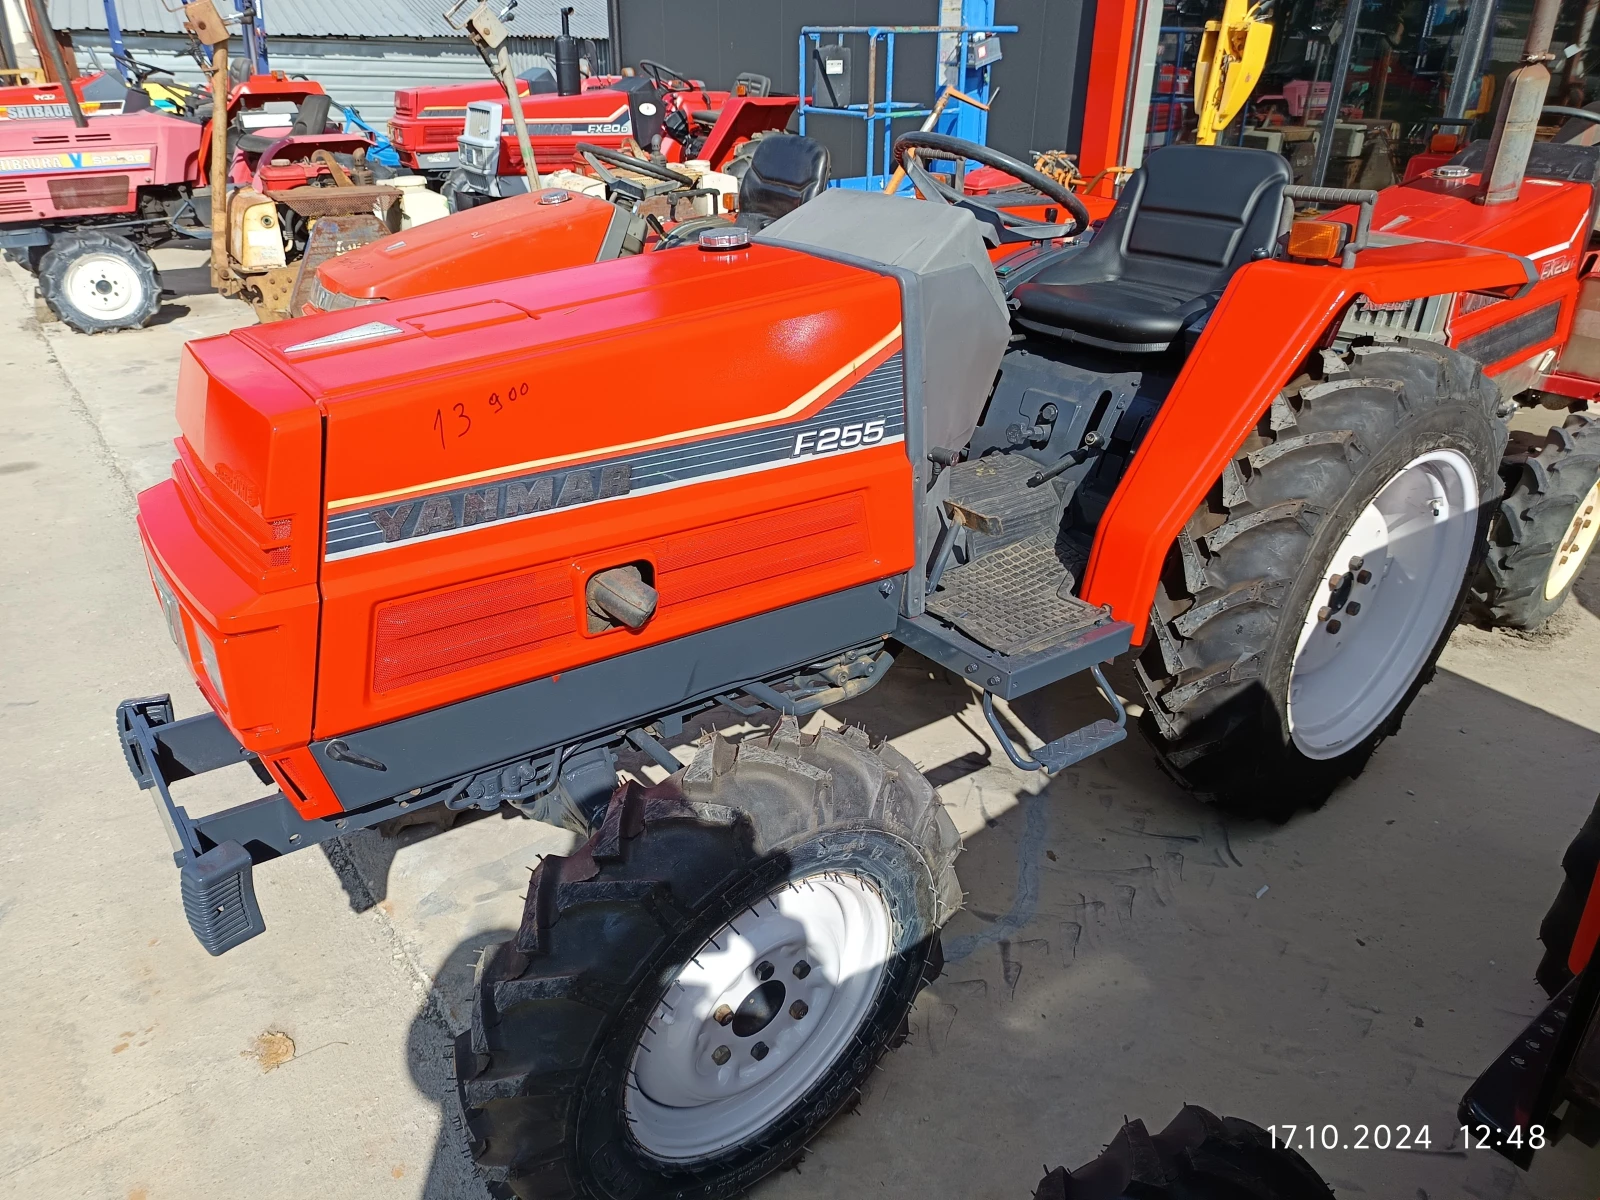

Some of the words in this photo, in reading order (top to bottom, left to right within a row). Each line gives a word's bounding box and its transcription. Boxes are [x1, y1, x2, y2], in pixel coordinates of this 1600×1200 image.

[8, 105, 78, 119] SHIBAUR
[434, 403, 471, 450] 13
[489, 383, 528, 413] 900
[369, 464, 632, 543] YANMAR
[792, 418, 886, 457] F255
